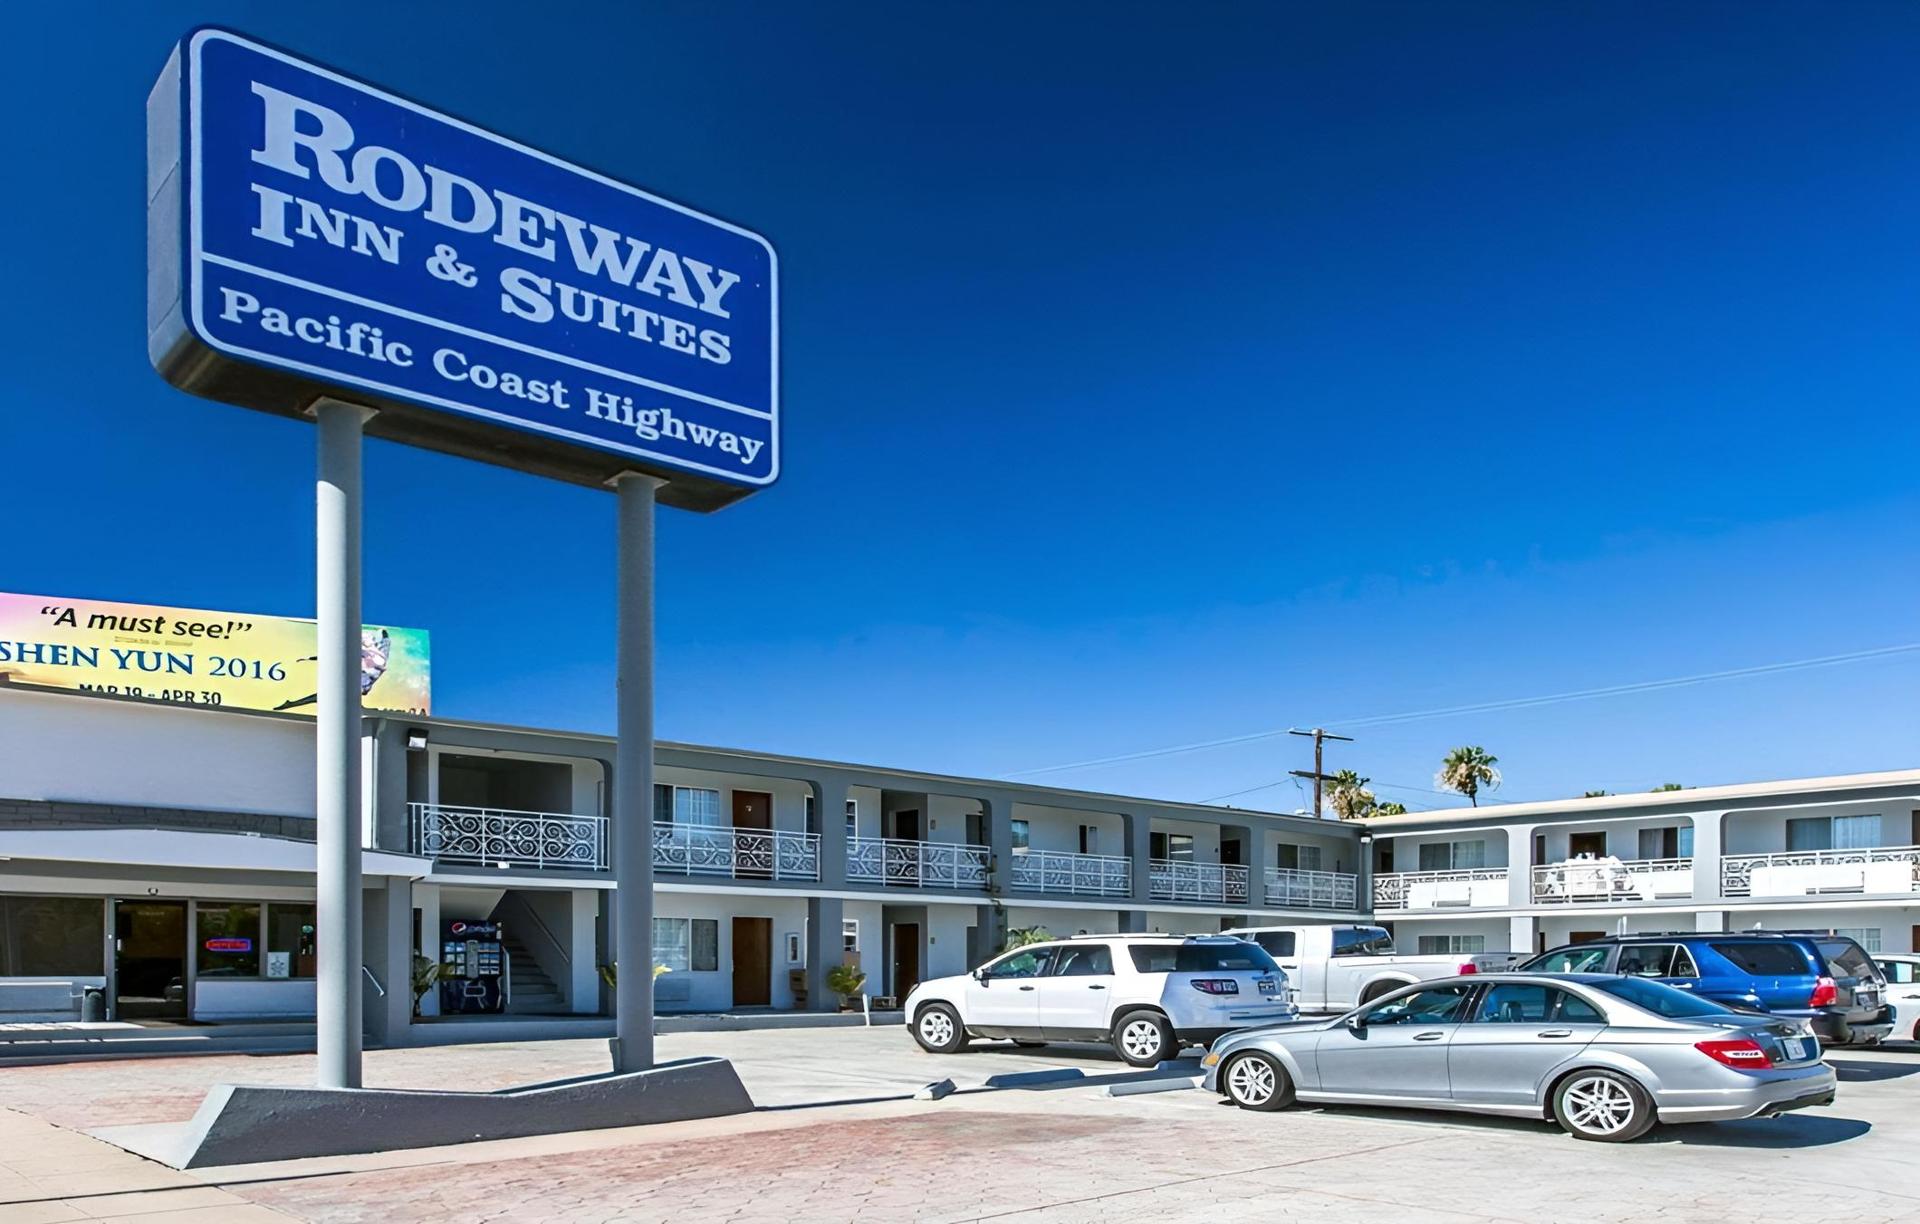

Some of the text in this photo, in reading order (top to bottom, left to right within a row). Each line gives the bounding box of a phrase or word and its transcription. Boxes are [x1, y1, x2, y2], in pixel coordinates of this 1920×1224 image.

[251, 80, 741, 319] RODEWAY
[251, 183, 732, 365] INN & SUITES
[219, 287, 765, 465] Pacific Coast Highway
[0, 640, 287, 681] SHEN YUN 2016
[87, 614, 166, 635] must
[161, 688, 196, 705] APR
[200, 690, 222, 707] 30
